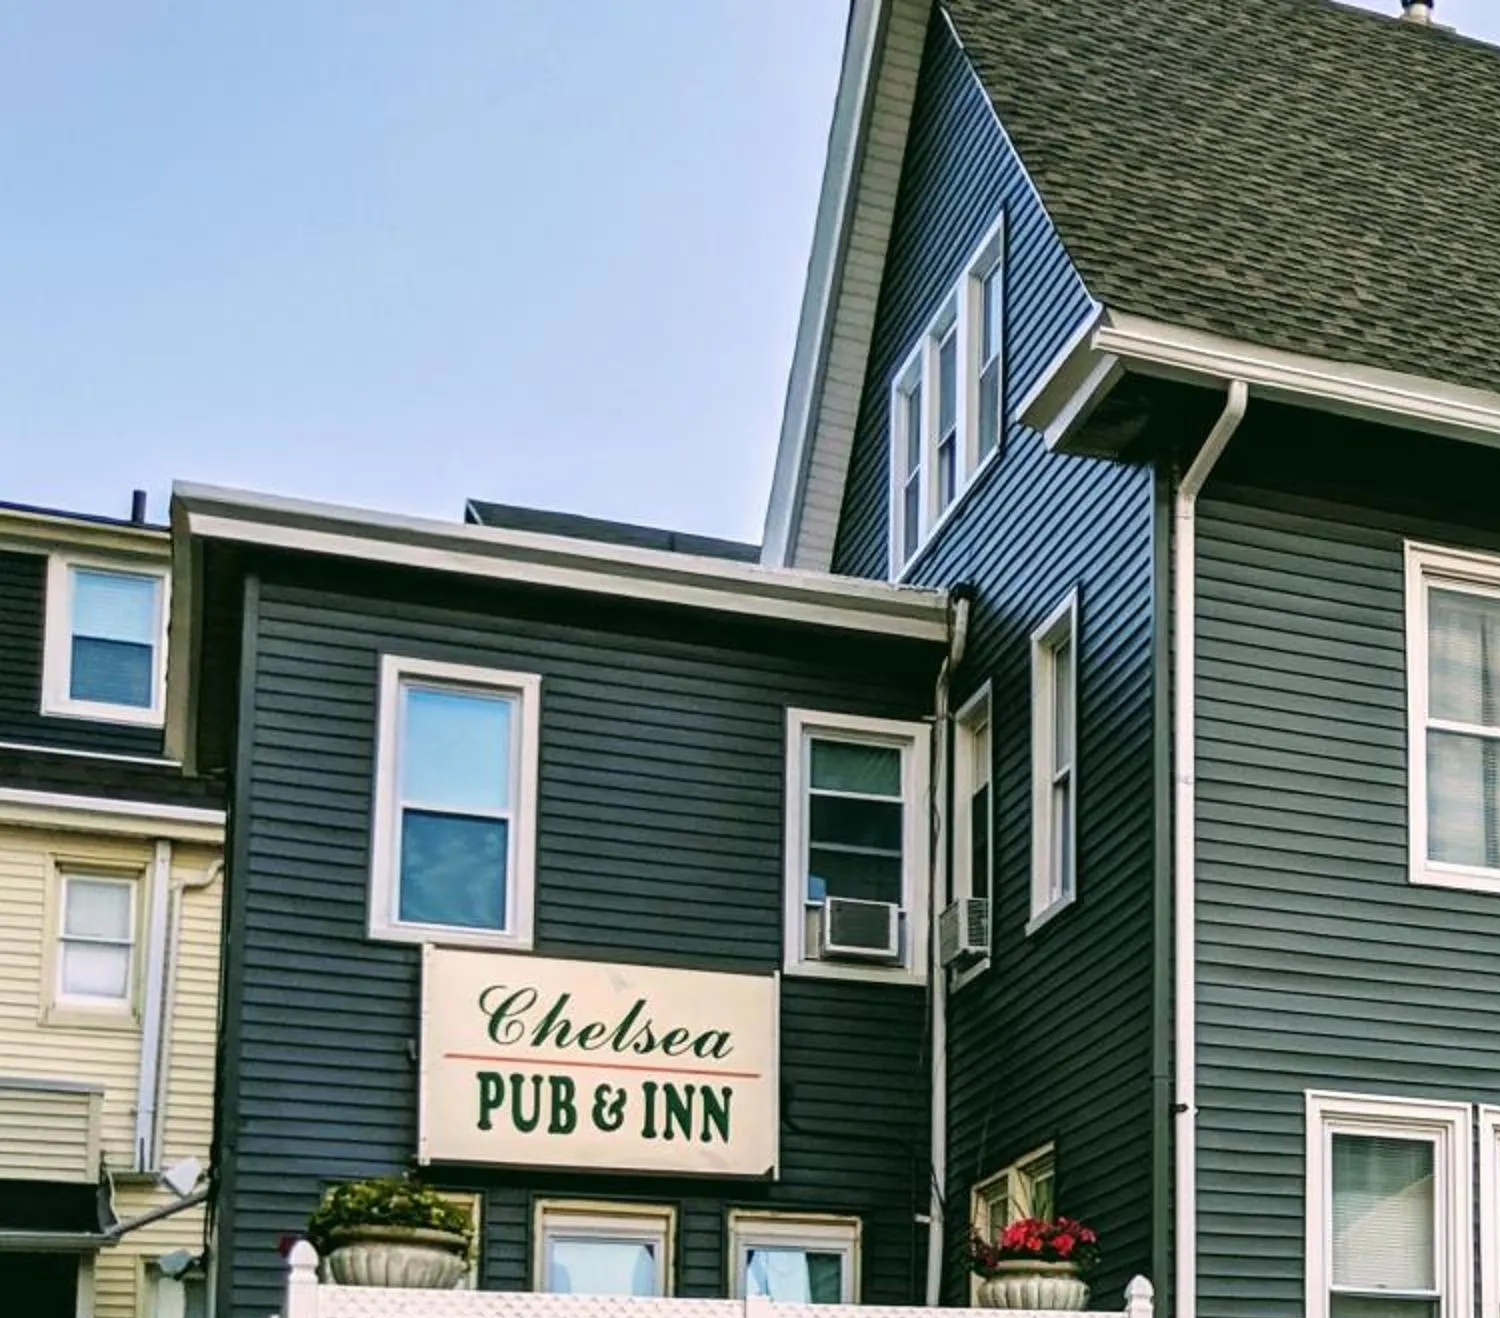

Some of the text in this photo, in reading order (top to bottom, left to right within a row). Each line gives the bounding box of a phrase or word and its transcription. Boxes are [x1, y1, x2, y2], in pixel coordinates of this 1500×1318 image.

[478, 984, 734, 1060] Chelsea
[476, 1071, 733, 1144] PUB & INN
